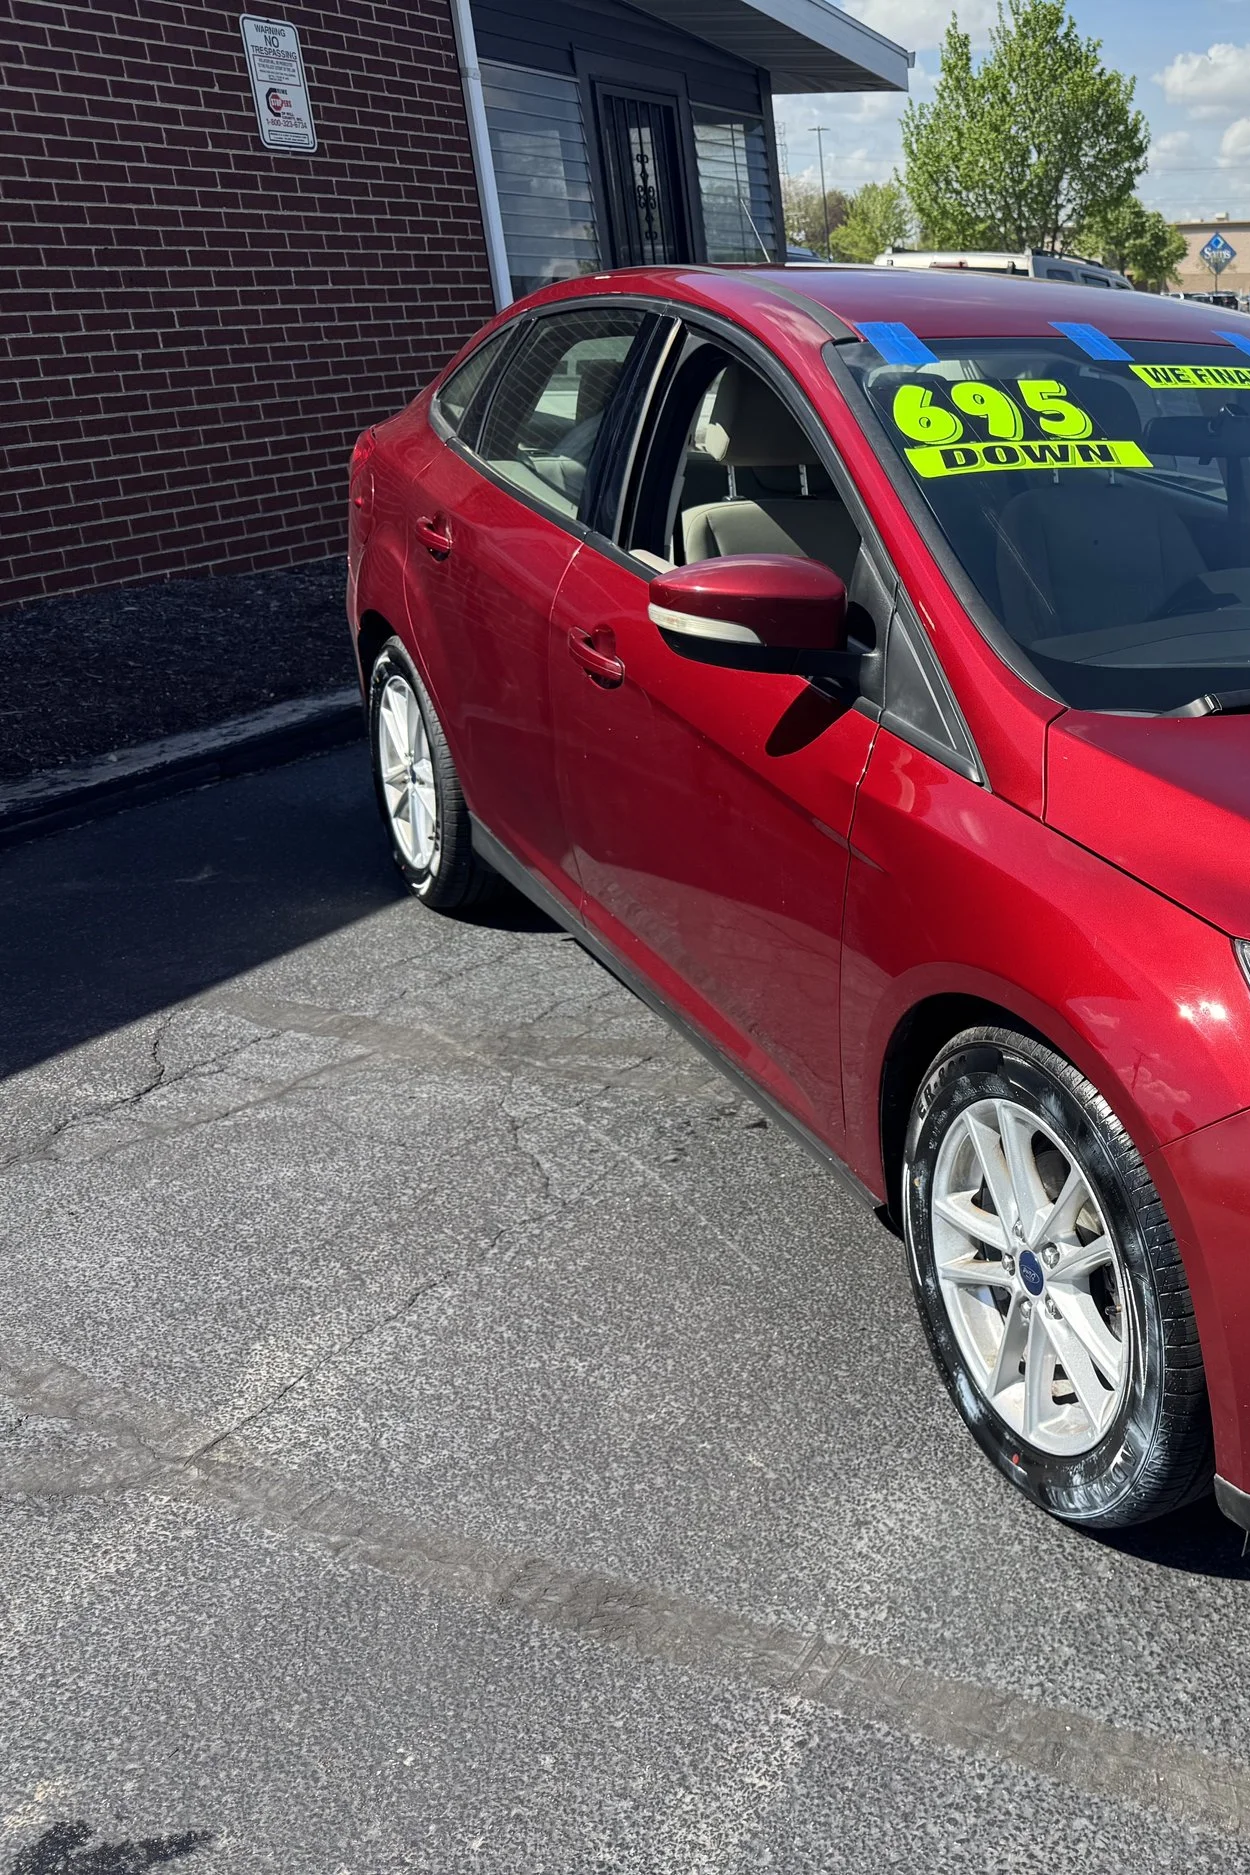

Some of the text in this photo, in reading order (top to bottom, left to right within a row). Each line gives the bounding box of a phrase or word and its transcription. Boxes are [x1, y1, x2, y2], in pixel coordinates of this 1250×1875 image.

[254, 23, 286, 37] WARNING
[264, 34, 279, 48] NO
[250, 45, 297, 60] TRESPASSING
[1142, 367, 1191, 385] WE
[893, 379, 1093, 445] 695
[939, 444, 1119, 471] DOWN
